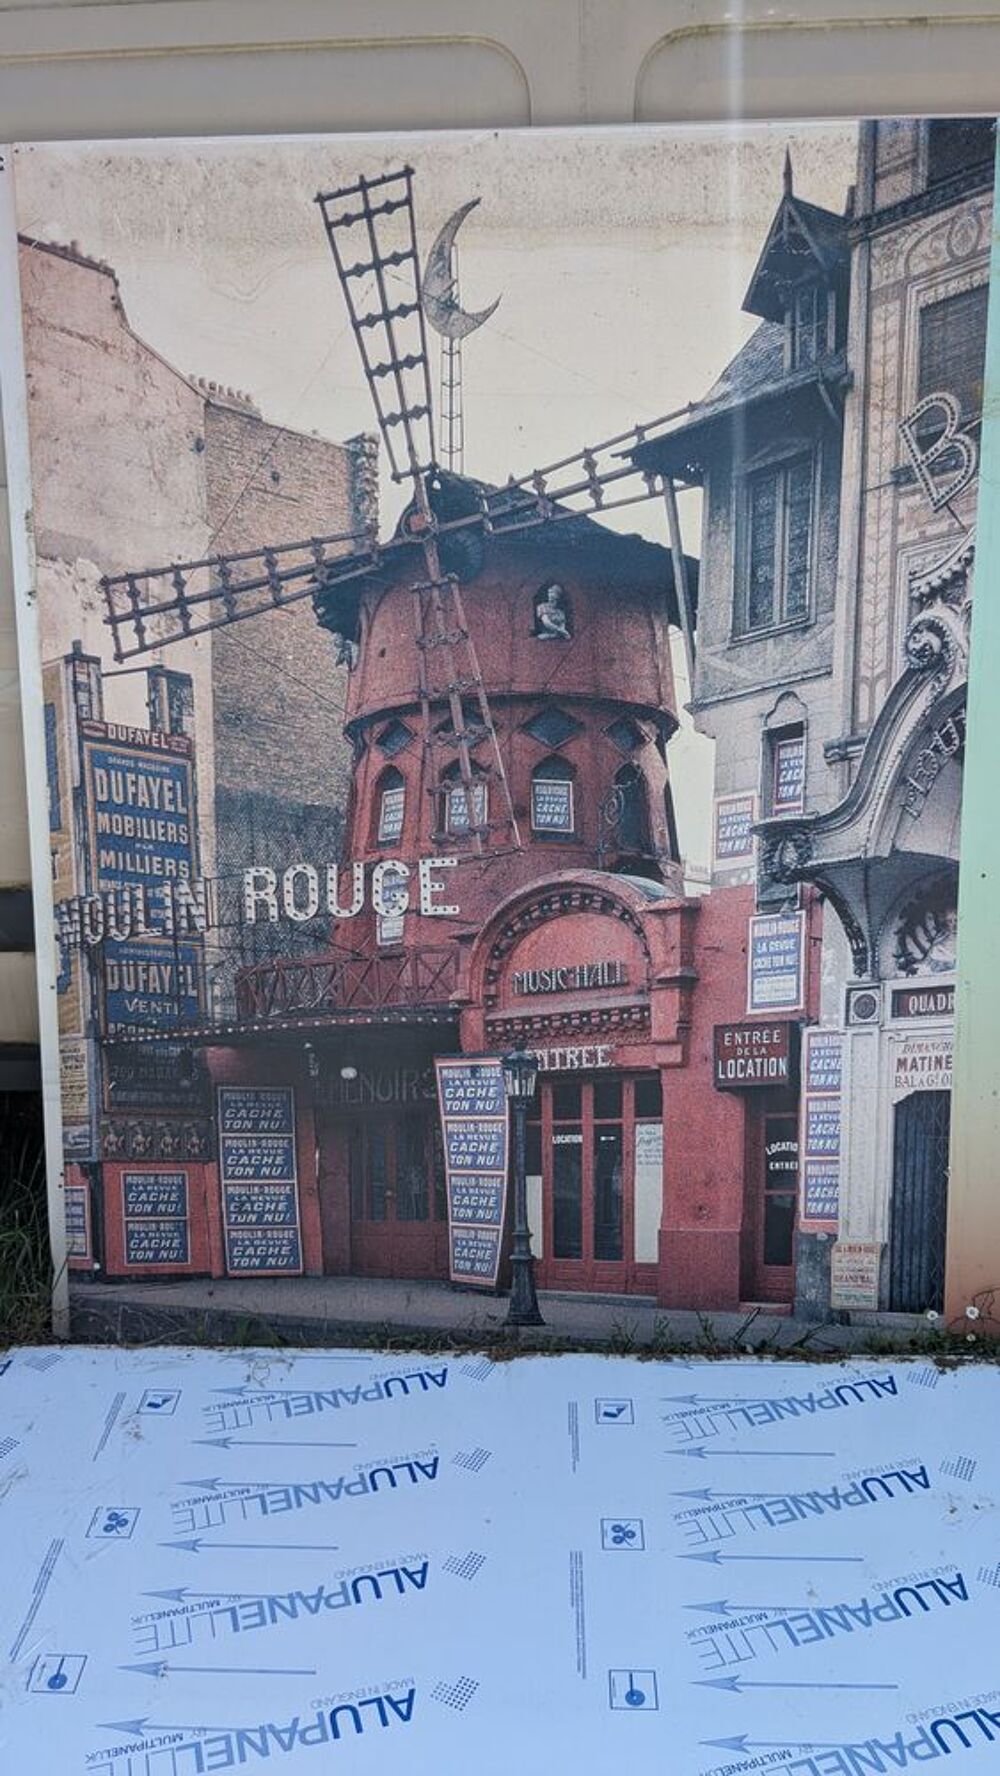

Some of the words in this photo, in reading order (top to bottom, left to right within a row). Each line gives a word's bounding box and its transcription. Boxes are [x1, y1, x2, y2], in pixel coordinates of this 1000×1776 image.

[899, 392, 976, 512] B
[107, 724, 170, 749] DUFAYEL
[94, 768, 188, 814] DUFAYEL
[97, 811, 189, 844] MOBILIERS
[101, 849, 190, 879] MILLIERS
[244, 858, 460, 924] ROUGE
[723, 1028, 781, 1046] ENTRÉE
[718, 1057, 788, 1079] LOCATION
[445, 1087, 498, 1099] CACHE
[445, 1100, 470, 1111] TON
[225, 1109, 284, 1118] CACHE
[225, 1119, 254, 1129] TON
[449, 1142, 499, 1152] CACHE
[226, 1155, 286, 1166] CACHE
[450, 1154, 472, 1165] TON
[226, 1166, 255, 1176] TON
[128, 1192, 180, 1202] CACHE
[452, 1195, 498, 1207] CACHE
[127, 1203, 154, 1213] TON
[229, 1202, 289, 1212] CACHE
[453, 1207, 473, 1218] TON
[229, 1213, 258, 1223] TON
[129, 1239, 182, 1249] CACHE
[129, 1250, 154, 1260] TON
[232, 1246, 293, 1256] CACHE
[454, 1247, 493, 1260] CACHE
[232, 1257, 261, 1267] TON
[454, 1260, 472, 1271] TON
[132, 1561, 429, 1656] ALUPANELLITE
[690, 1573, 969, 1670] ALUPANELLITE
